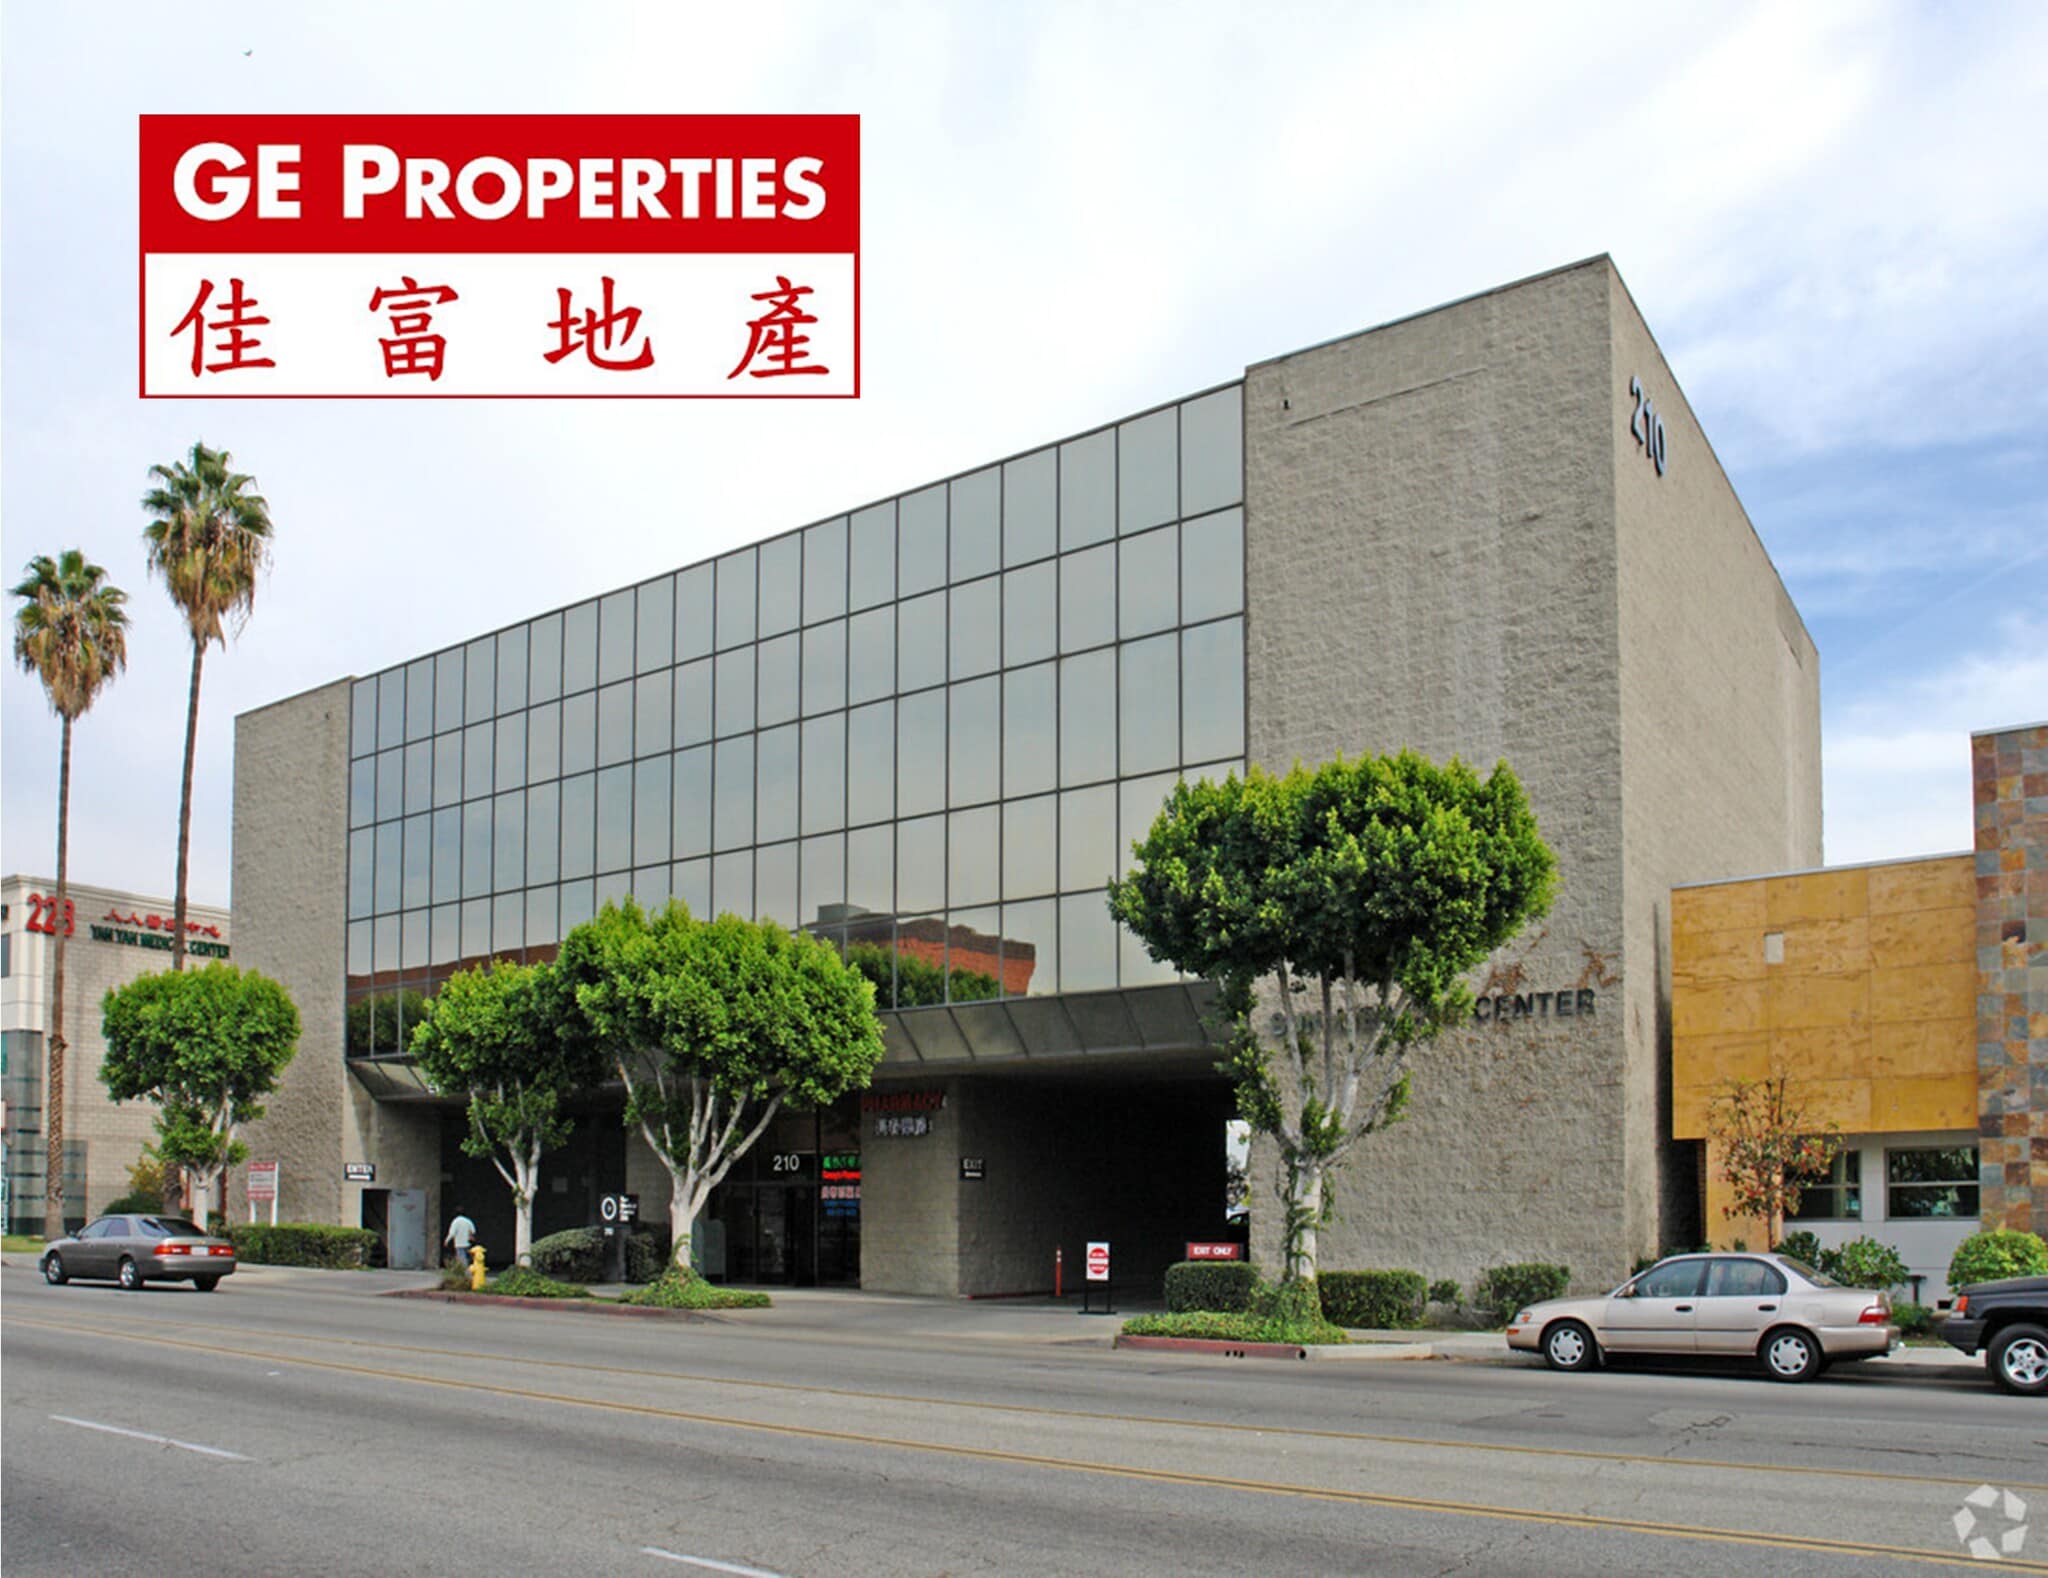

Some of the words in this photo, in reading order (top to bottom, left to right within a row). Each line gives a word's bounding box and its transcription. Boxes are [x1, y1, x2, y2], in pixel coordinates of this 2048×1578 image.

[1629, 375, 1668, 477] 210
[26, 892, 75, 938] 223
[139, 932, 187, 952] MEDIC
[189, 940, 230, 958] CENTER
[1474, 987, 1597, 1020] CENTER
[773, 1154, 800, 1171] 210
[963, 1158, 983, 1170] EXIT
[1193, 1246, 1211, 1255] EXIT
[1213, 1246, 1233, 1256] ONLY
